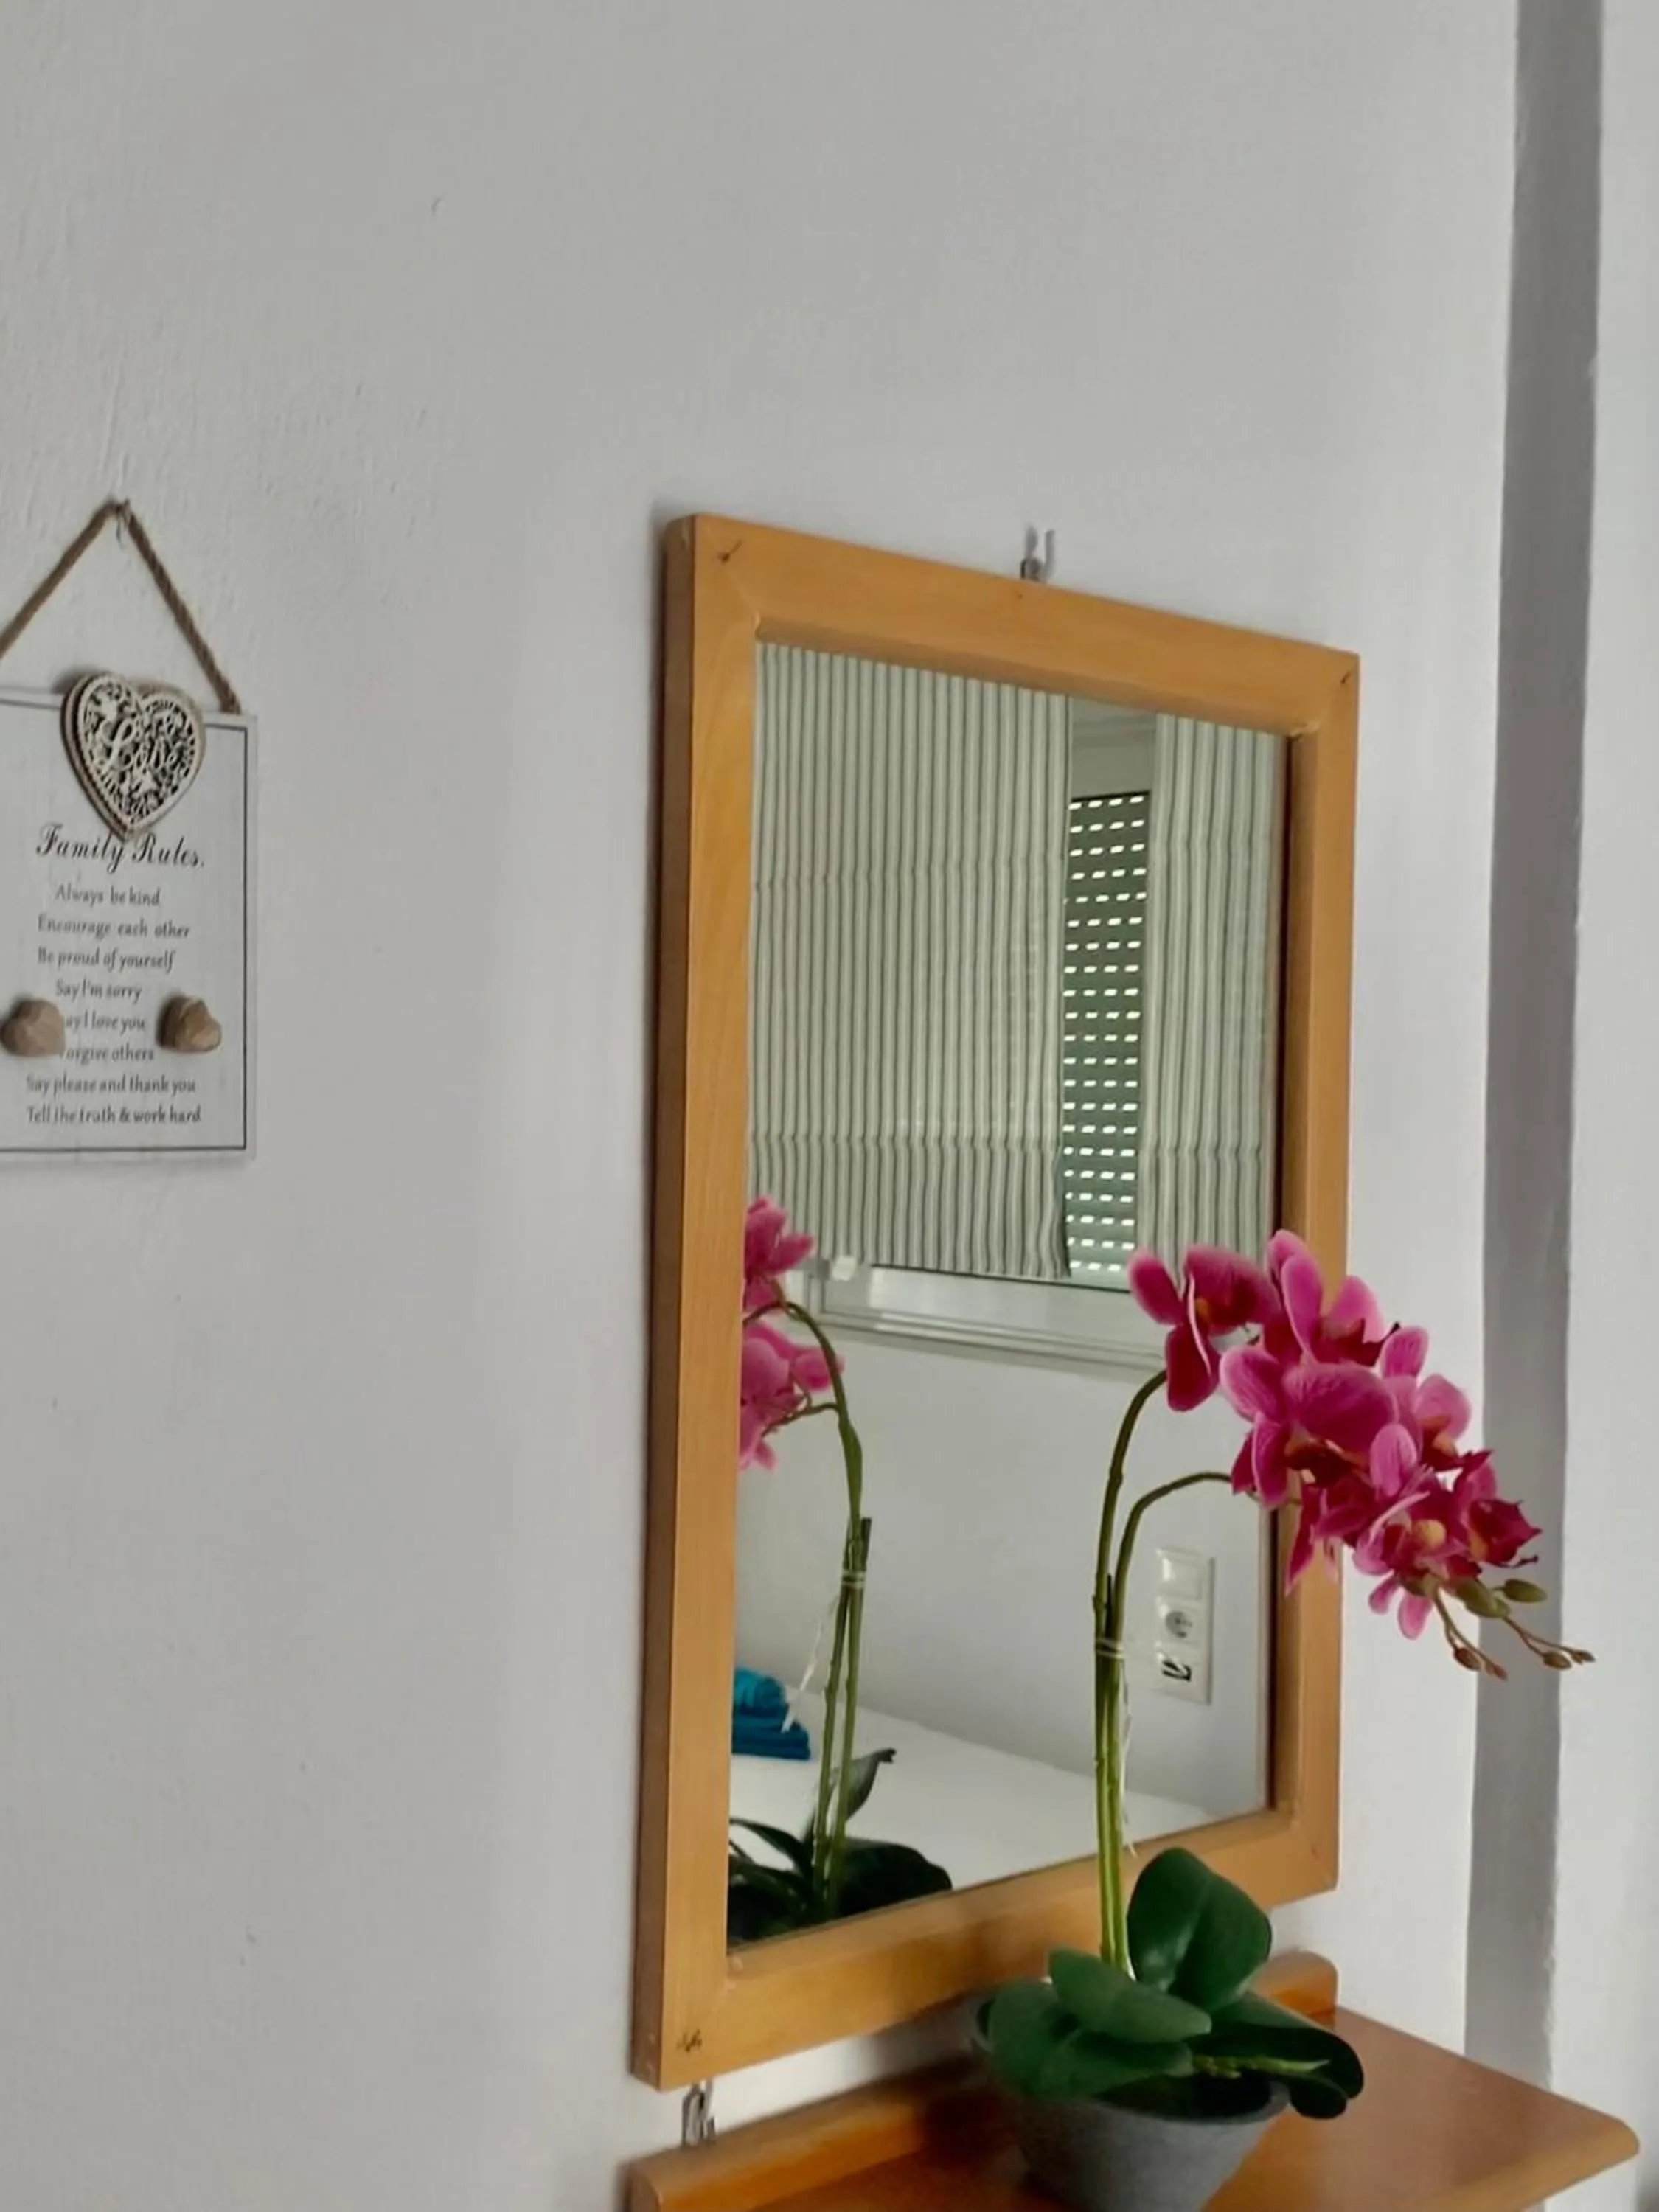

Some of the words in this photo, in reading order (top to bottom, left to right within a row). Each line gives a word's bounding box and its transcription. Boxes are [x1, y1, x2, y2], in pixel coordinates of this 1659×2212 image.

[36, 822, 125, 874] Family
[55, 885, 104, 908] Always
[111, 886, 125, 905] be
[129, 888, 161, 906] kind
[38, 914, 111, 940] Encourage
[118, 919, 148, 936] each
[155, 923, 190, 938] other
[58, 949, 100, 968] proud
[103, 948, 119, 967] of
[119, 950, 176, 973] yourself
[56, 979, 81, 1002] Say
[107, 986, 142, 1003] sorry
[66, 1016, 80, 1032] ay
[92, 1010, 119, 1030] love
[119, 1018, 145, 1036] you
[60, 1047, 108, 1066] orgive
[111, 1042, 154, 1062] others
[27, 1074, 50, 1096] Say
[54, 1072, 97, 1099] please
[100, 1073, 126, 1092] and
[129, 1074, 169, 1093] thank
[171, 1079, 196, 1097] you
[27, 1106, 51, 1123] Tell
[54, 1106, 77, 1122] the
[80, 1106, 116, 1124] truth
[119, 1107, 131, 1124] &
[133, 1106, 166, 1124] work
[170, 1105, 201, 1124] hard
